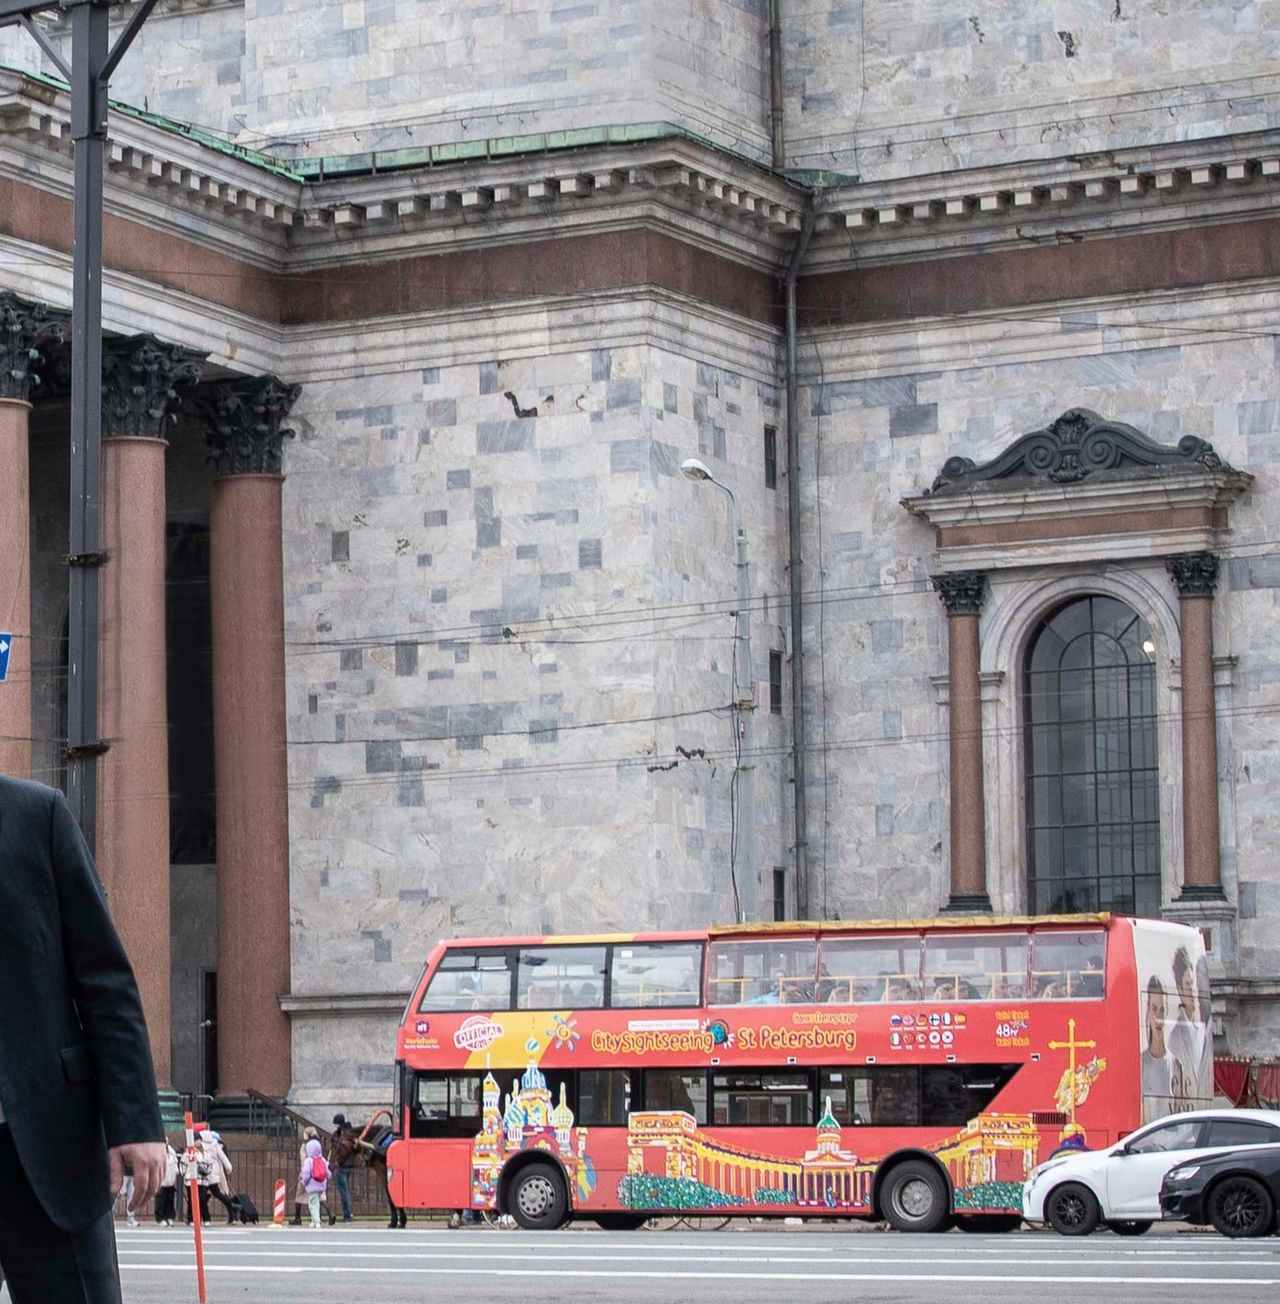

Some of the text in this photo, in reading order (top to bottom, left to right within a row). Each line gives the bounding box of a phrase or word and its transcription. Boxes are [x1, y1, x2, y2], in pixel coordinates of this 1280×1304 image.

[456, 1025, 502, 1045] OFFICIAL
[592, 1024, 858, 1054] CitySightseeing St Petersburg
